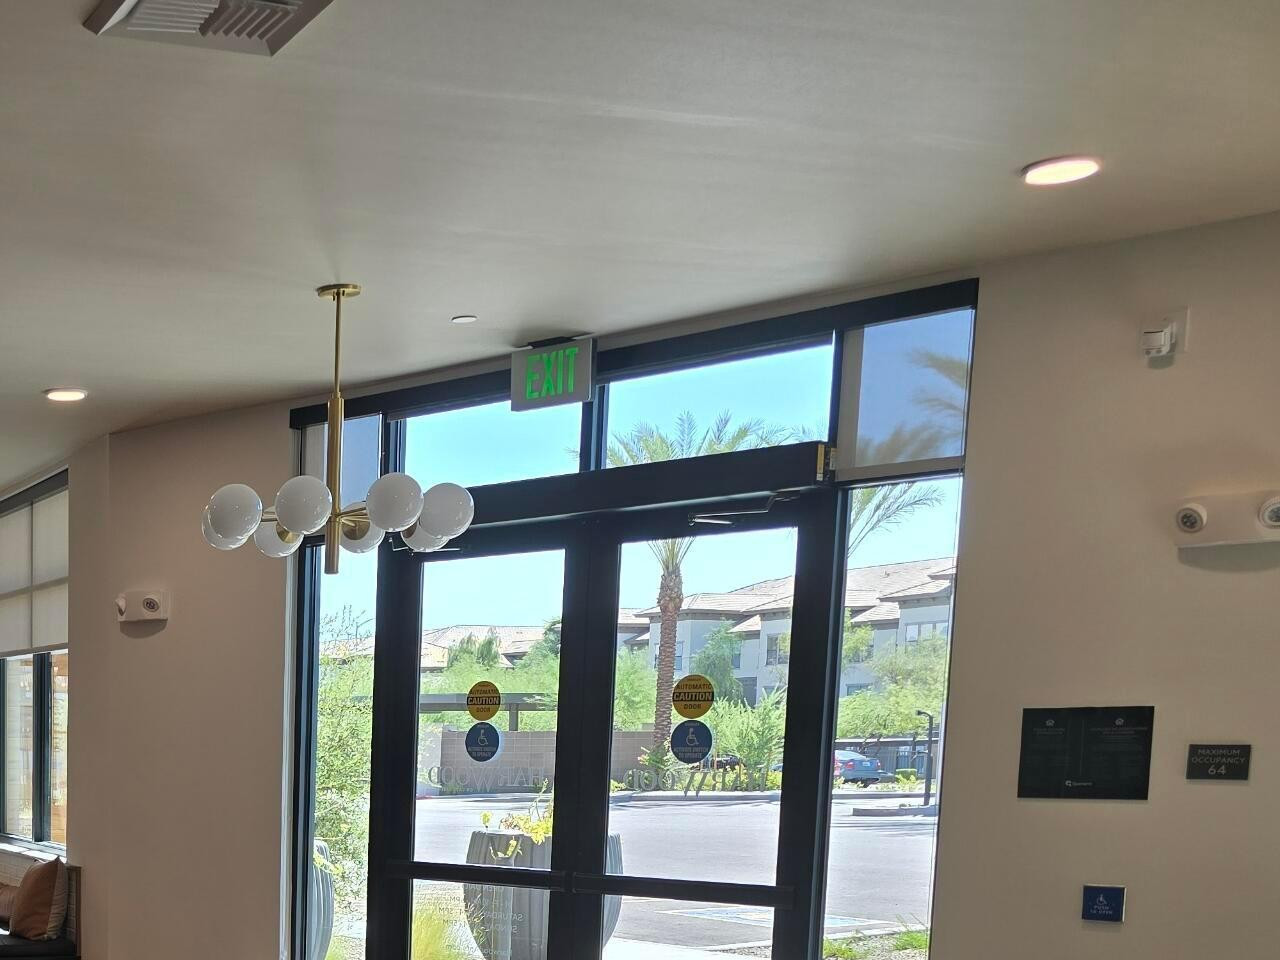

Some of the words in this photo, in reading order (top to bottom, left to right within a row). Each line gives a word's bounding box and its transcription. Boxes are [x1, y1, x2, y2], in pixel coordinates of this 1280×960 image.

[526, 347, 579, 400] EXIT
[674, 692, 713, 701] CAUTION
[468, 697, 499, 705] CAUTION
[1198, 748, 1241, 756] MAXIMUM
[1191, 756, 1246, 764] OCCUPANCY
[1208, 765, 1227, 775] 64
